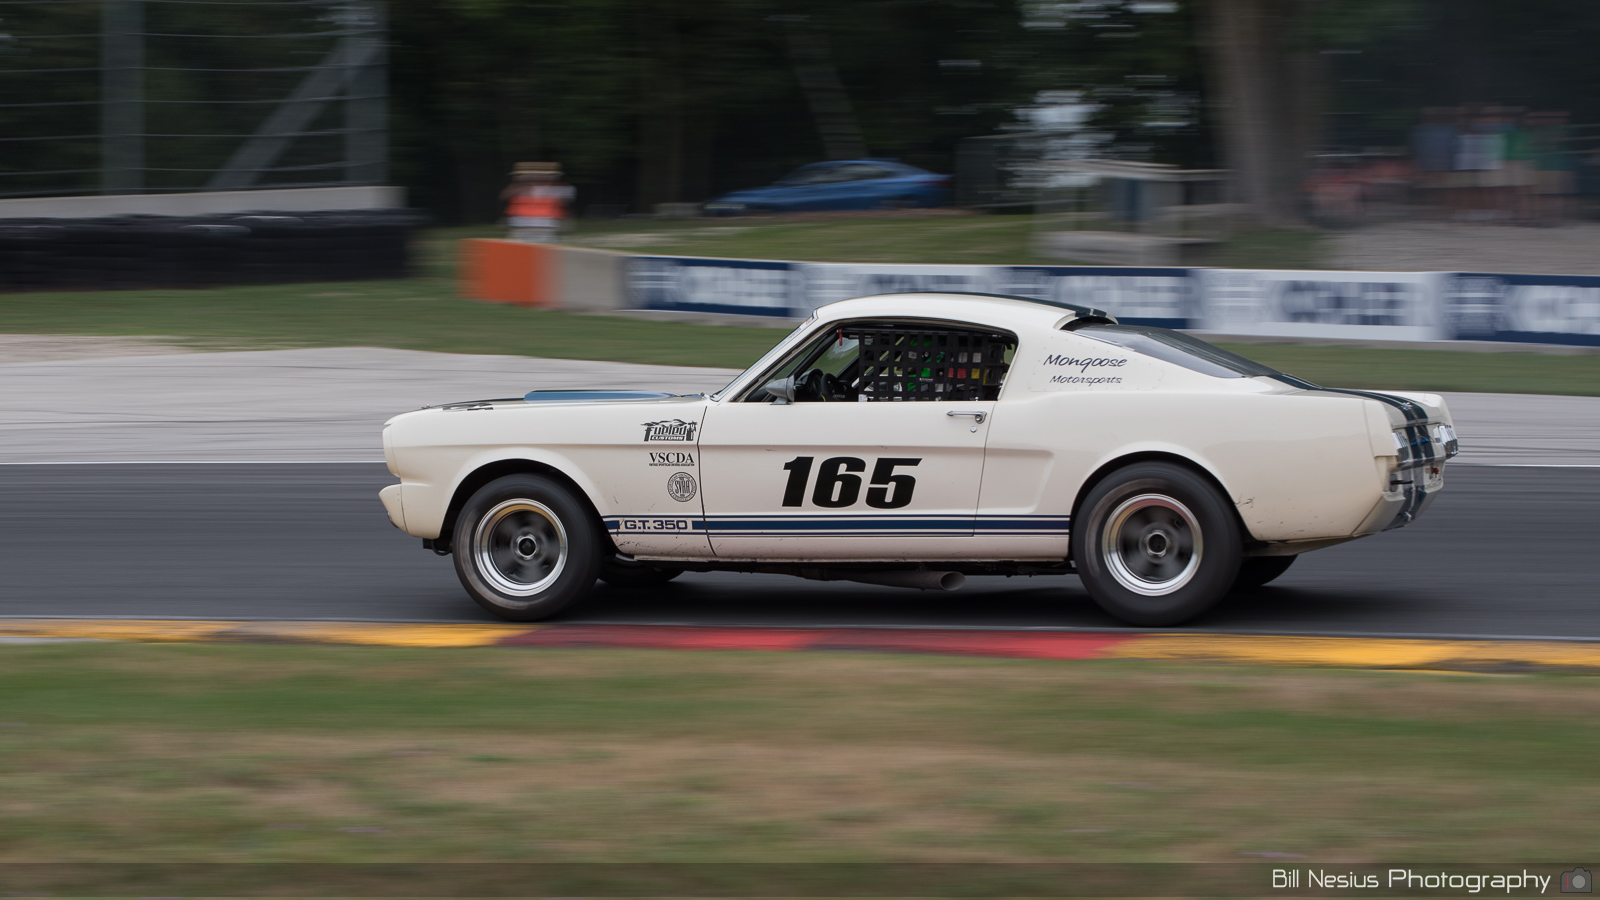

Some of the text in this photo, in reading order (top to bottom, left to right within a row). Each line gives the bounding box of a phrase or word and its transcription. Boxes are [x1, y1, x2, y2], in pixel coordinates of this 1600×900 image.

[1043, 354, 1128, 373] Mongoose
[1049, 375, 1123, 387] Motorsports
[649, 452, 695, 463] VSCDA
[782, 456, 923, 509] 165
[624, 520, 688, 530] G.T. 350
